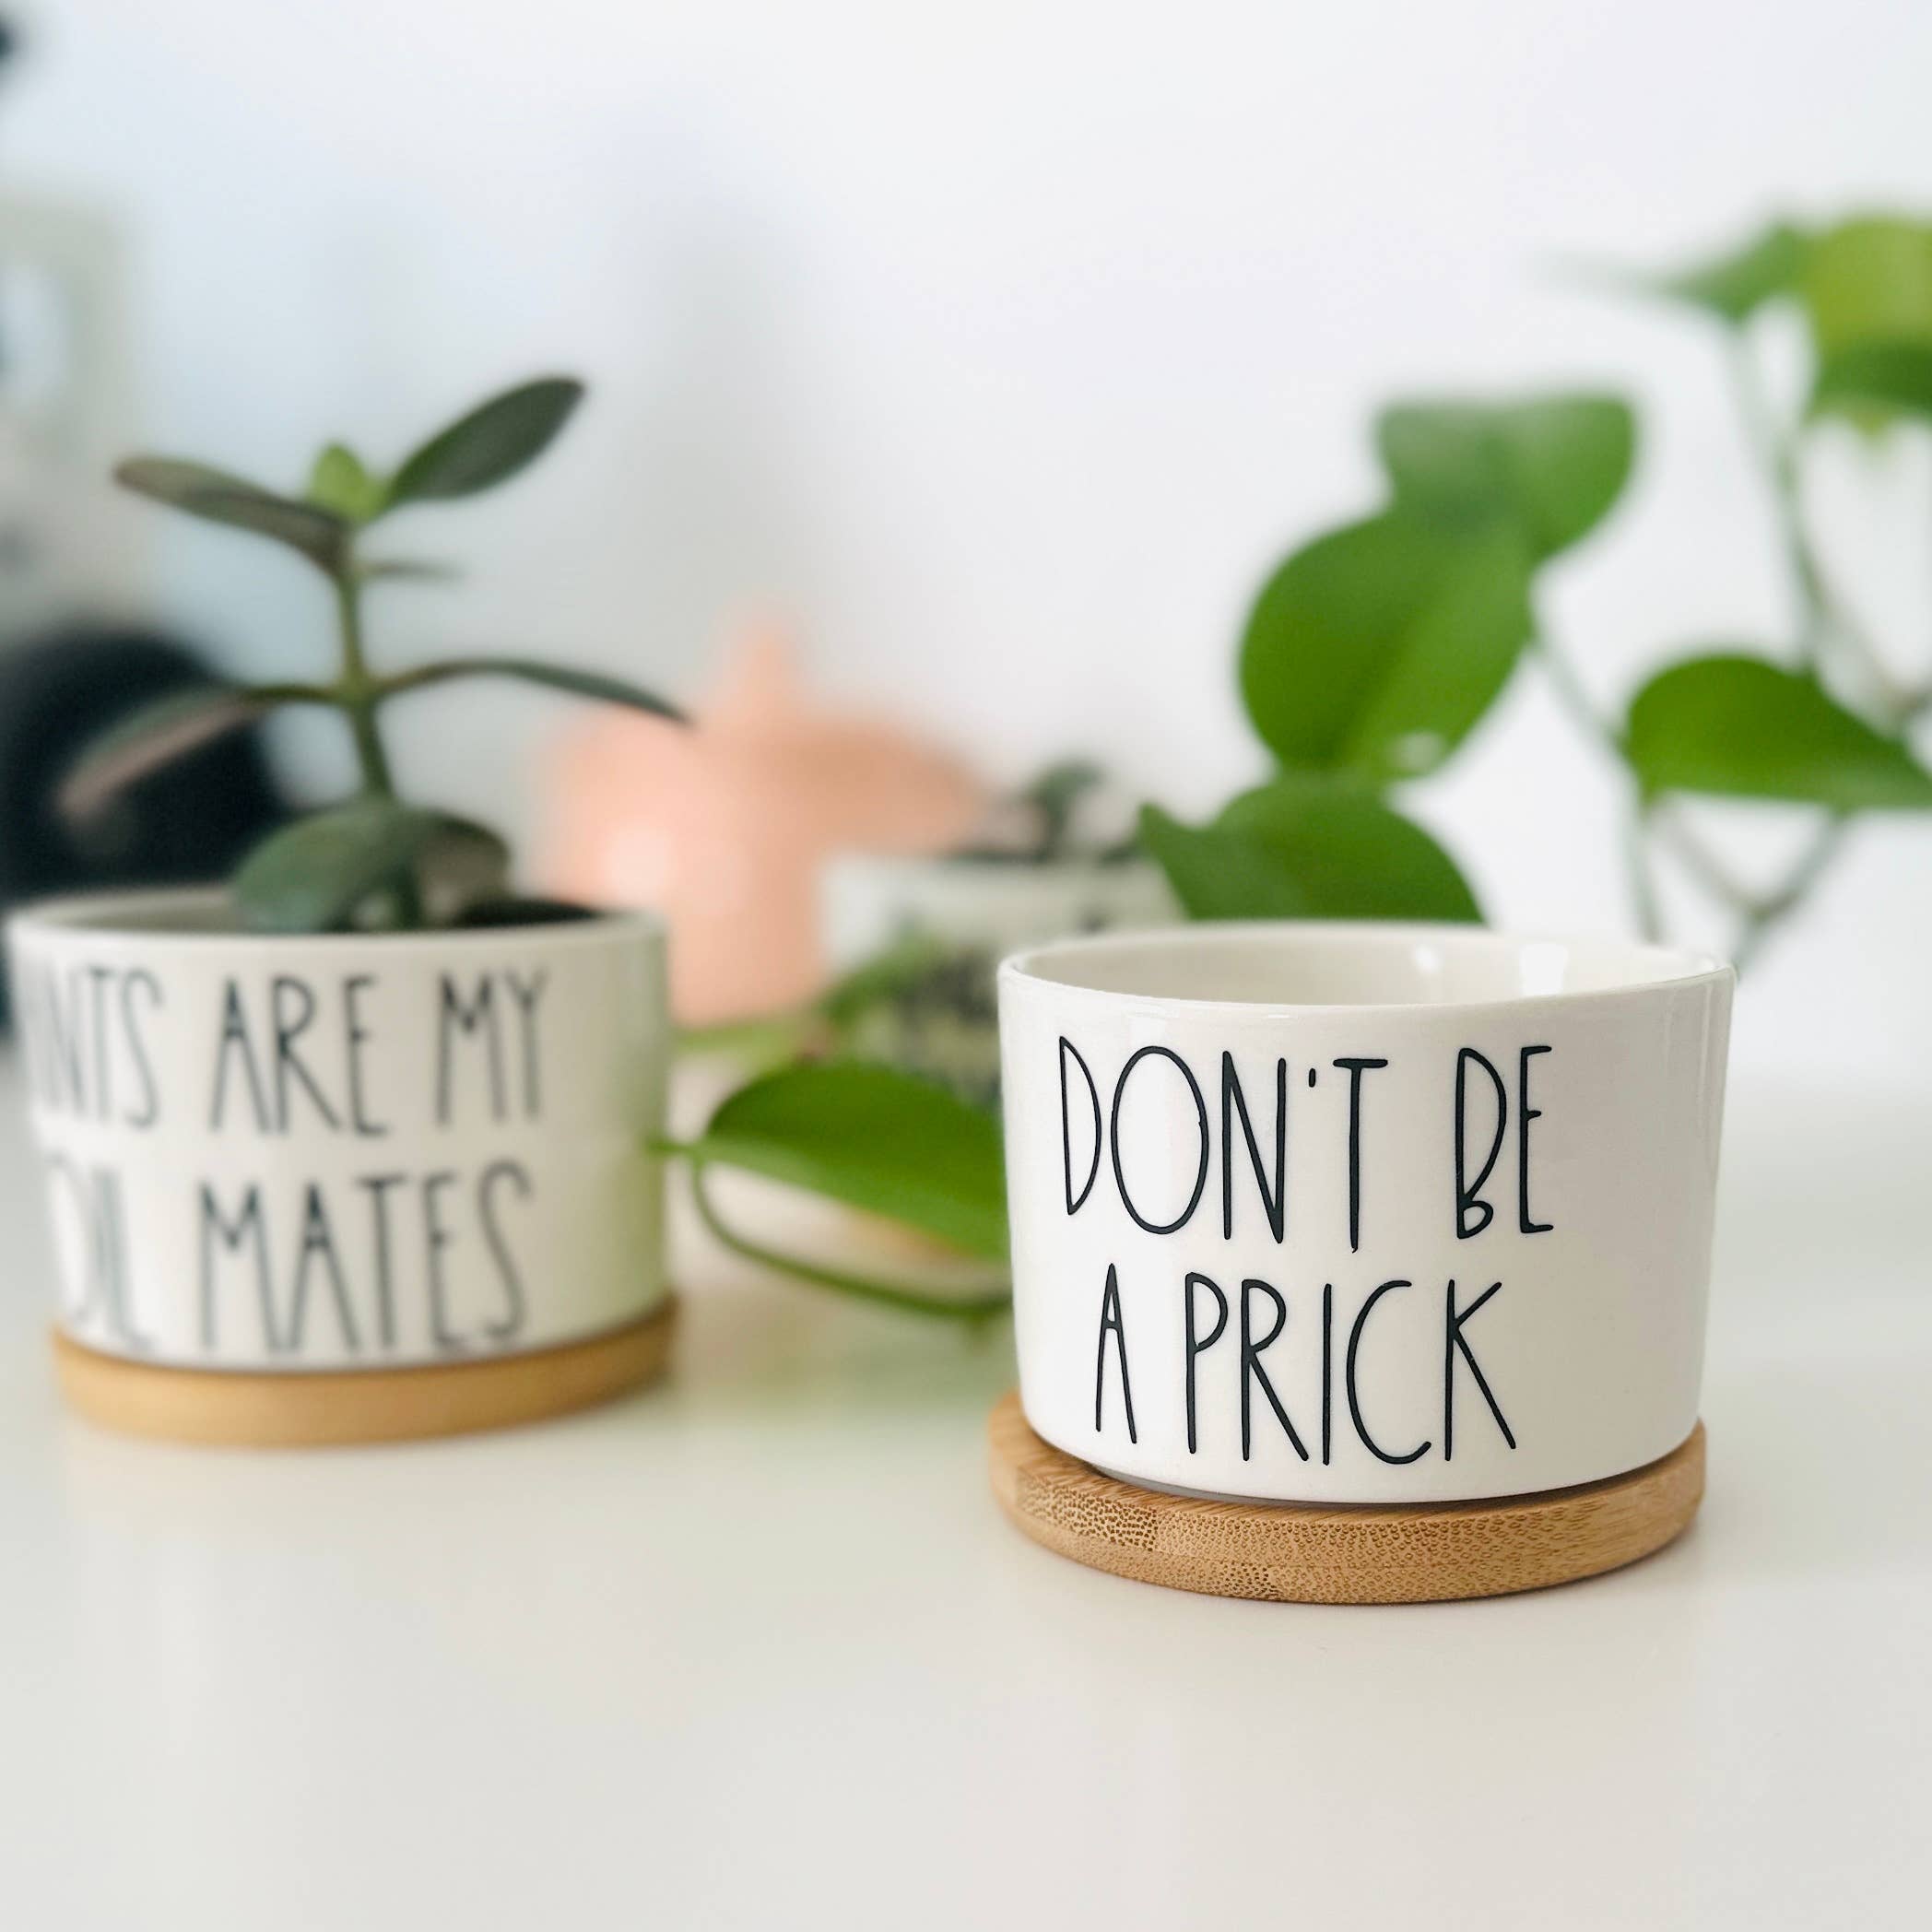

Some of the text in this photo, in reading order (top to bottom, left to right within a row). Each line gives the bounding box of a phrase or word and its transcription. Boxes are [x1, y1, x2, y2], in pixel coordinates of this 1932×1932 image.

[37, 963, 548, 1138] NTS ARE MY
[1058, 1035, 1555, 1255] DON'T BE
[198, 1157, 534, 1354] MATES
[1095, 1263, 1517, 1467] A PRICK
